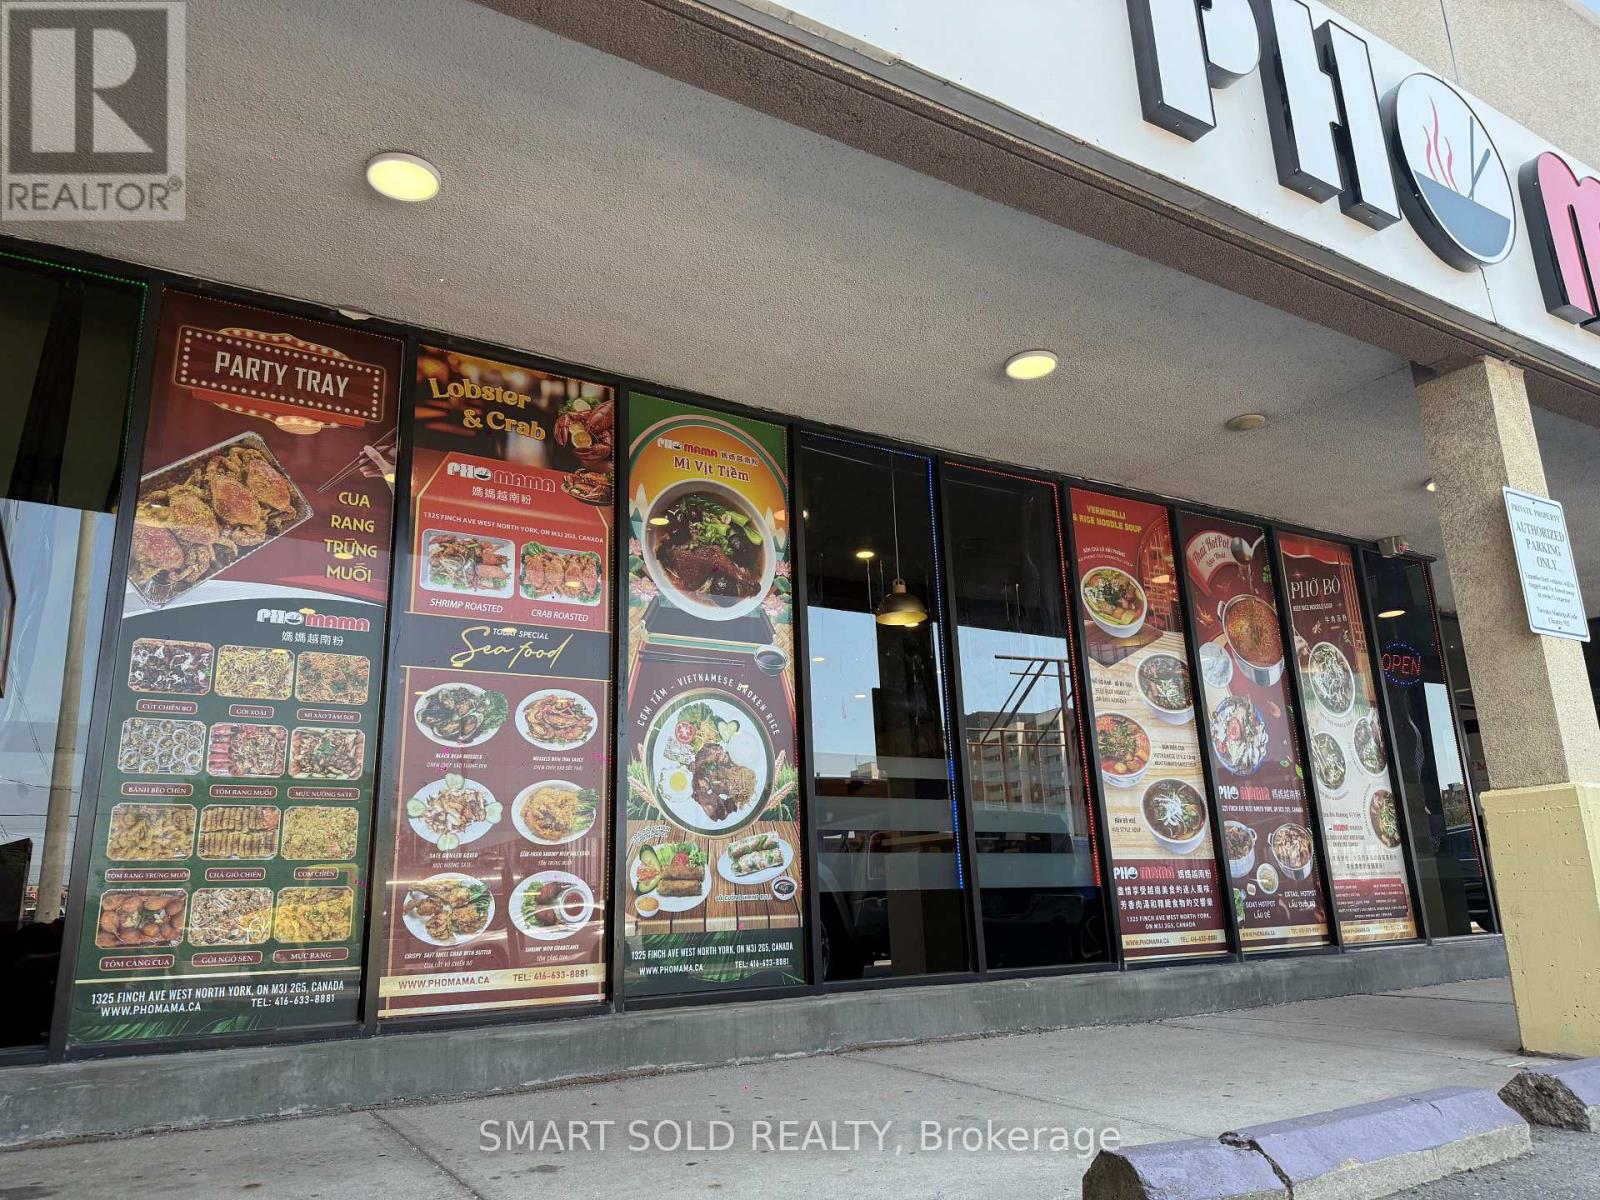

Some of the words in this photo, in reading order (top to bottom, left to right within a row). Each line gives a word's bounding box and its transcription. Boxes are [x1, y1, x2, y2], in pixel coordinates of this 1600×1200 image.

[214, 351, 288, 385] PARTY
[294, 366, 349, 398] TRAY
[428, 378, 531, 409] Lobster
[463, 408, 484, 429] &
[486, 411, 546, 441] Crab
[673, 456, 690, 470] Mì
[694, 460, 714, 476] Vịt
[338, 491, 371, 508] CUA
[1086, 504, 1126, 519] VERMICELLI
[1534, 510, 1560, 523] PROPERTY
[330, 514, 375, 533] RANG
[423, 512, 440, 521] 1325
[440, 514, 462, 523] FINCH
[477, 519, 495, 527] WEST
[496, 522, 519, 531] NORTH
[540, 528, 550, 536] ON
[578, 534, 604, 544] CANADA
[1080, 515, 1095, 525] RICE
[1097, 517, 1123, 530] NOODLE
[1125, 522, 1142, 534] SOUP
[1516, 521, 1565, 543] AUTHORIZED
[1525, 538, 1561, 557] PARKING
[1536, 556, 1557, 570] ONLY
[429, 598, 464, 611] SHRIMP
[464, 601, 503, 614] ROASTED
[531, 608, 552, 618] CRAB
[553, 610, 589, 622] ROASTED
[518, 630, 550, 640] SPECIAL
[450, 625, 515, 665] Sea
[508, 633, 574, 669] food
[1382, 653, 1421, 676] OPEN
[677, 673, 734, 687] VIETNAMESE
[765, 713, 780, 736] RICE
[1140, 914, 1154, 922] FINCH
[1166, 913, 1178, 921] WEST
[1179, 912, 1196, 920] NORTH
[1176, 920, 1196, 929] CANADA
[632, 950, 646, 960] 1325
[648, 950, 666, 960] FINCH
[668, 949, 679, 958] AVE
[680, 948, 696, 957] WEST
[698, 946, 717, 956] NORTH
[737, 945, 745, 953] ON
[771, 942, 793, 951] CANADA
[639, 964, 703, 976] WWW.PHOMAMA.CA
[735, 960, 748, 969] TEL:
[398, 976, 490, 990] WWW.PHOMAMA.CA
[513, 973, 532, 983] TEL:
[533, 969, 589, 981] 416-633-8881
[91, 993, 115, 1005] 1325
[117, 990, 145, 1003] FINCH
[148, 990, 167, 1002] AVE
[169, 988, 195, 1001] WEST
[196, 987, 226, 999] NORTH
[256, 984, 269, 996] ON
[271, 983, 288, 994] M3J
[311, 980, 344, 992] CANADA
[100, 1002, 201, 1017] WWW.PHOMAMA.CA
[251, 998, 272, 1008] TEL:
[274, 994, 335, 1007] 416-633-8881
